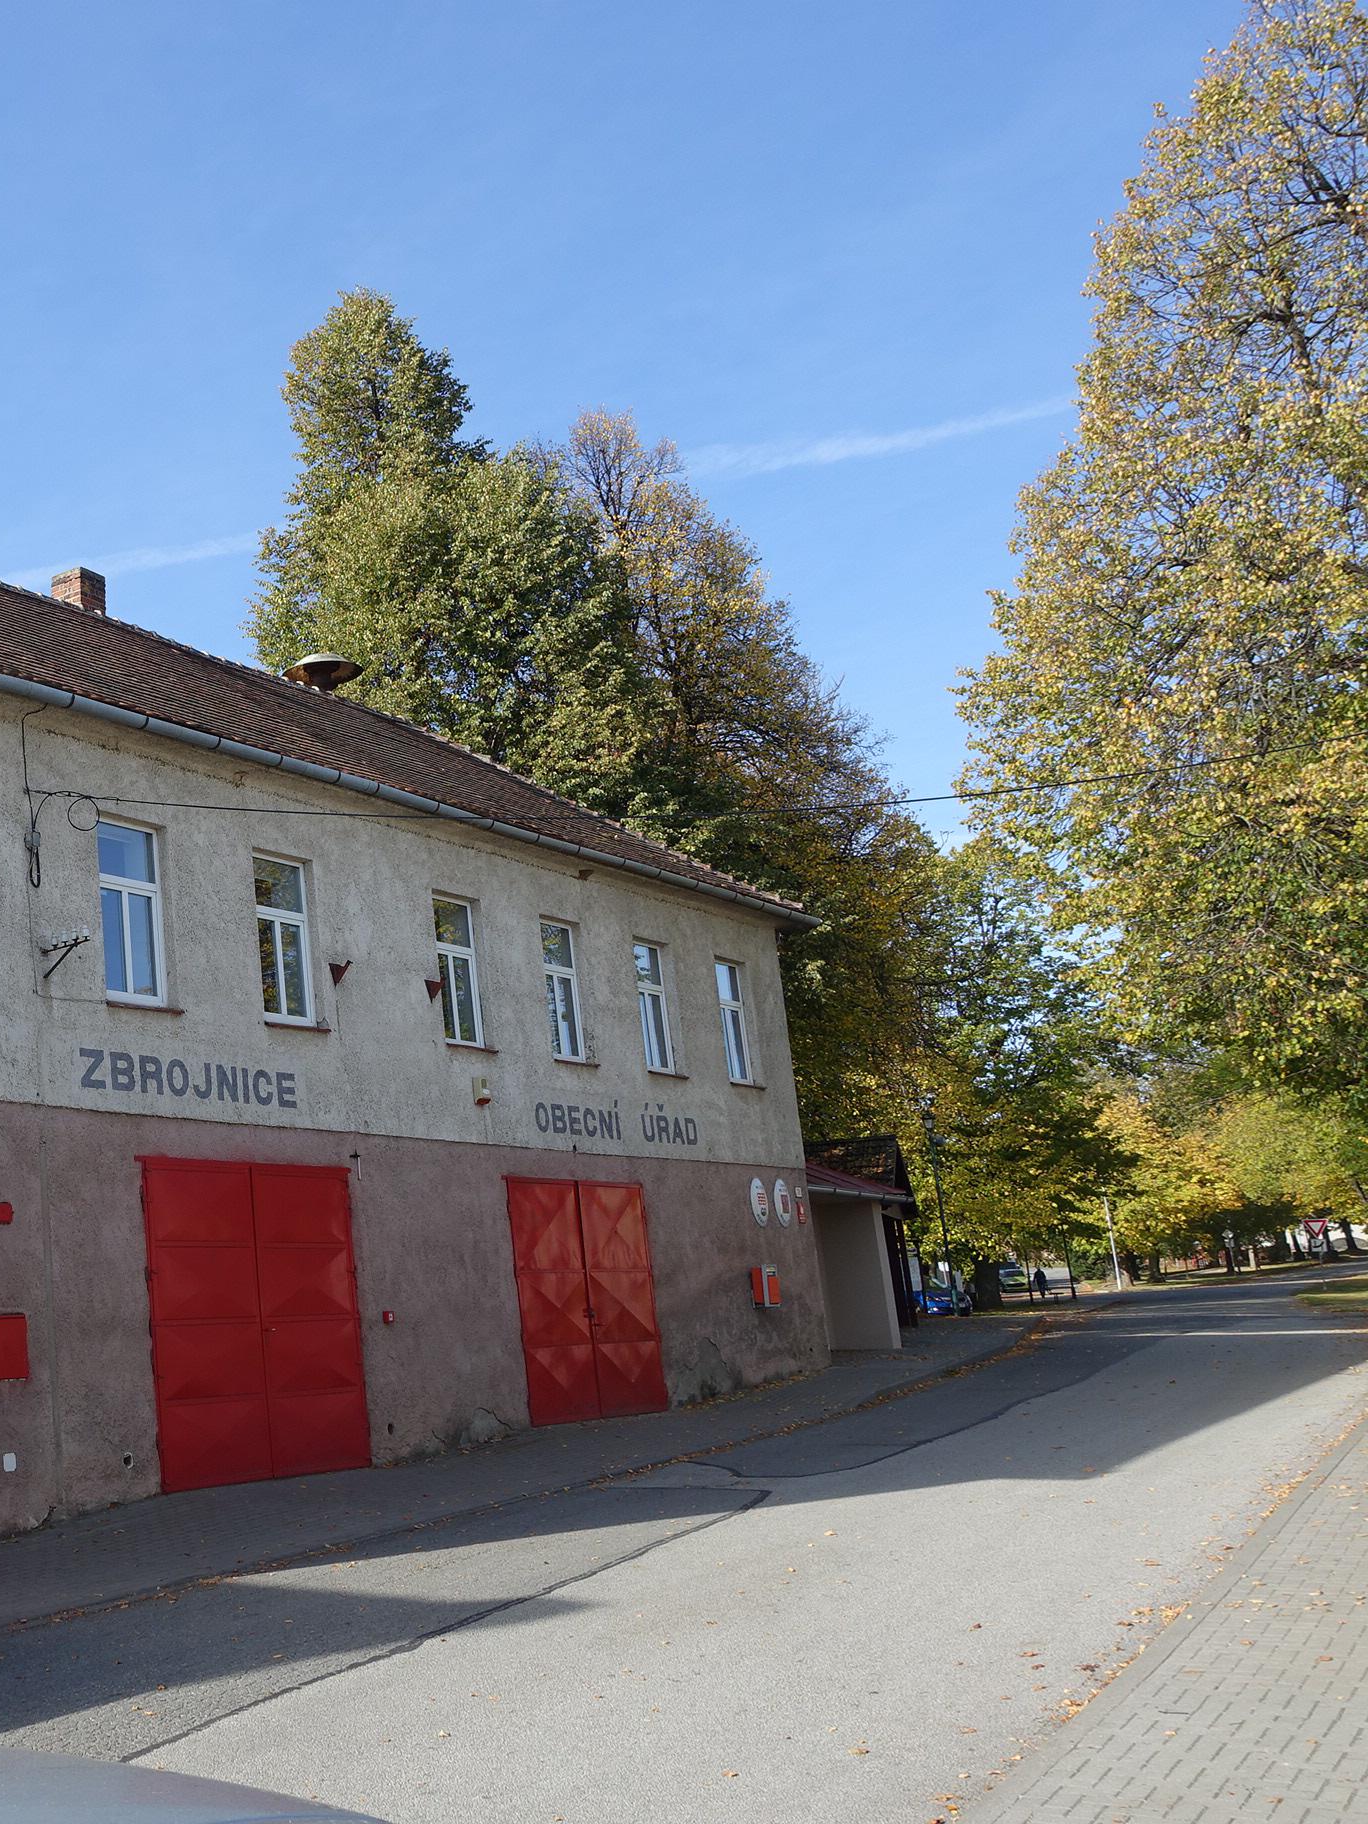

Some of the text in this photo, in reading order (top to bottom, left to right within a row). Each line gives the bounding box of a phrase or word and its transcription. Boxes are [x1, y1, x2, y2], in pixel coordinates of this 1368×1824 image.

[79, 1047, 297, 1108] ZBROJNICE
[534, 1099, 698, 1145] OBECNÍ ÚŘAD
